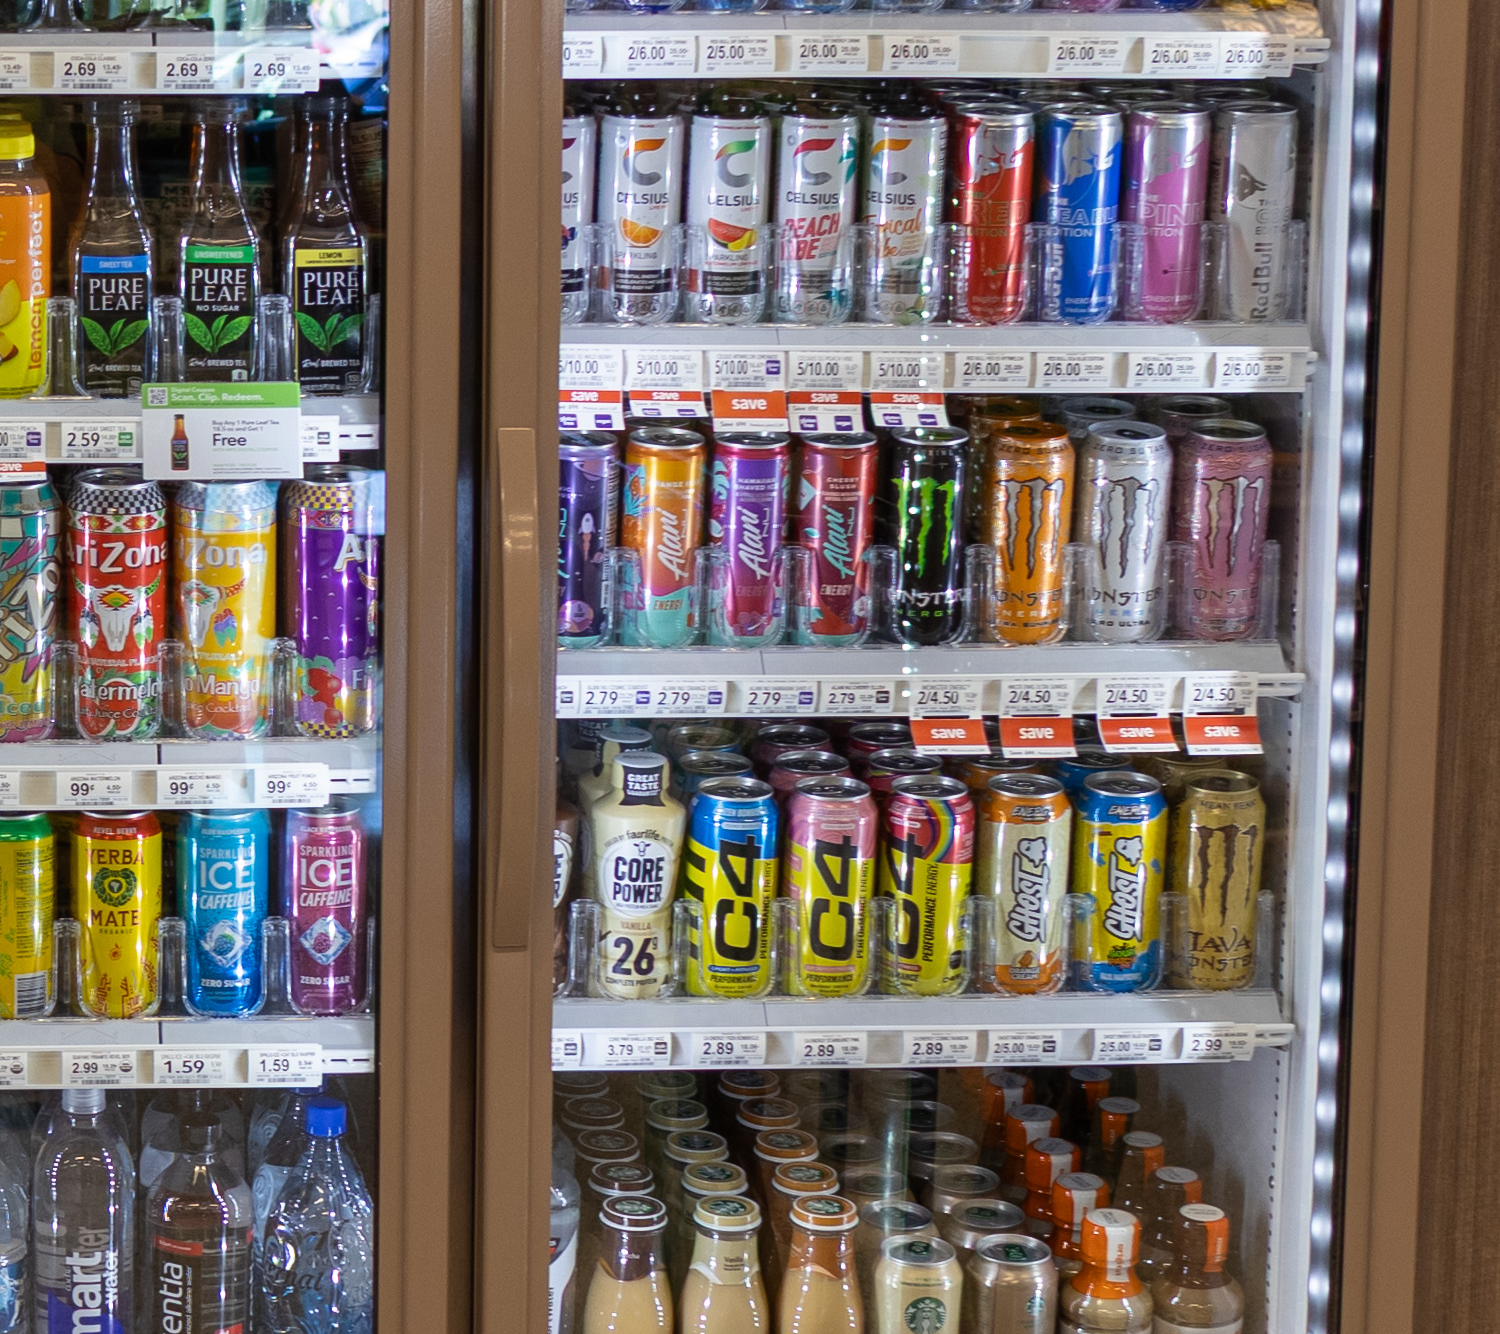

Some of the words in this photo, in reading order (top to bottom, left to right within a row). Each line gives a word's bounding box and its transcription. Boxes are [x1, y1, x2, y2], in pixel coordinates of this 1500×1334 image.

[629, 47, 665, 59] 2/6.00
[800, 45, 837, 57] 2/6.00
[1152, 50, 1188, 63] 2/6.00
[167, 63, 197, 76] 2.69
[617, 192, 669, 205] CELSIUS
[786, 192, 838, 204] CELSIUS
[192, 269, 246, 285] PURE
[304, 272, 358, 288] PURE
[89, 278, 144, 293] PURE
[715, 361, 748, 374] 5/10.00
[879, 364, 920, 377] 5/10.00
[1136, 363, 1171, 376] 2/6.00
[171, 393, 195, 402] Scan.
[199, 393, 220, 403] Clip.
[222, 393, 263, 402] Redeem.
[732, 398, 767, 410] save
[212, 433, 247, 447] Free
[738, 507, 761, 579] Alani
[823, 505, 854, 578] Alani
[586, 692, 617, 704] 2.79
[829, 693, 855, 703] 2.79
[1106, 690, 1147, 702] 2/4.50
[1019, 725, 1054, 739] save
[1203, 725, 1240, 737] save
[627, 773, 659, 782] GREAT
[627, 781, 659, 791] TASTE
[626, 828, 661, 841] fairlife
[300, 845, 353, 856] SPARKLING
[301, 859, 354, 887] ICE
[614, 857, 664, 881] CORE
[300, 888, 351, 906] CAFFEINE
[613, 883, 663, 903] POWER
[715, 836, 764, 961] C4
[810, 836, 856, 961] C4
[1008, 852, 1048, 942] GHOST
[1105, 852, 1144, 942] GHOST
[608, 1045, 633, 1055] 3.79
[913, 1043, 942, 1055] 2.89
[1100, 1042, 1129, 1052] 2/5.00
[73, 1063, 98, 1073] 2.99
[261, 1059, 289, 1071] 1.59
[103, 1252, 119, 1305] water
